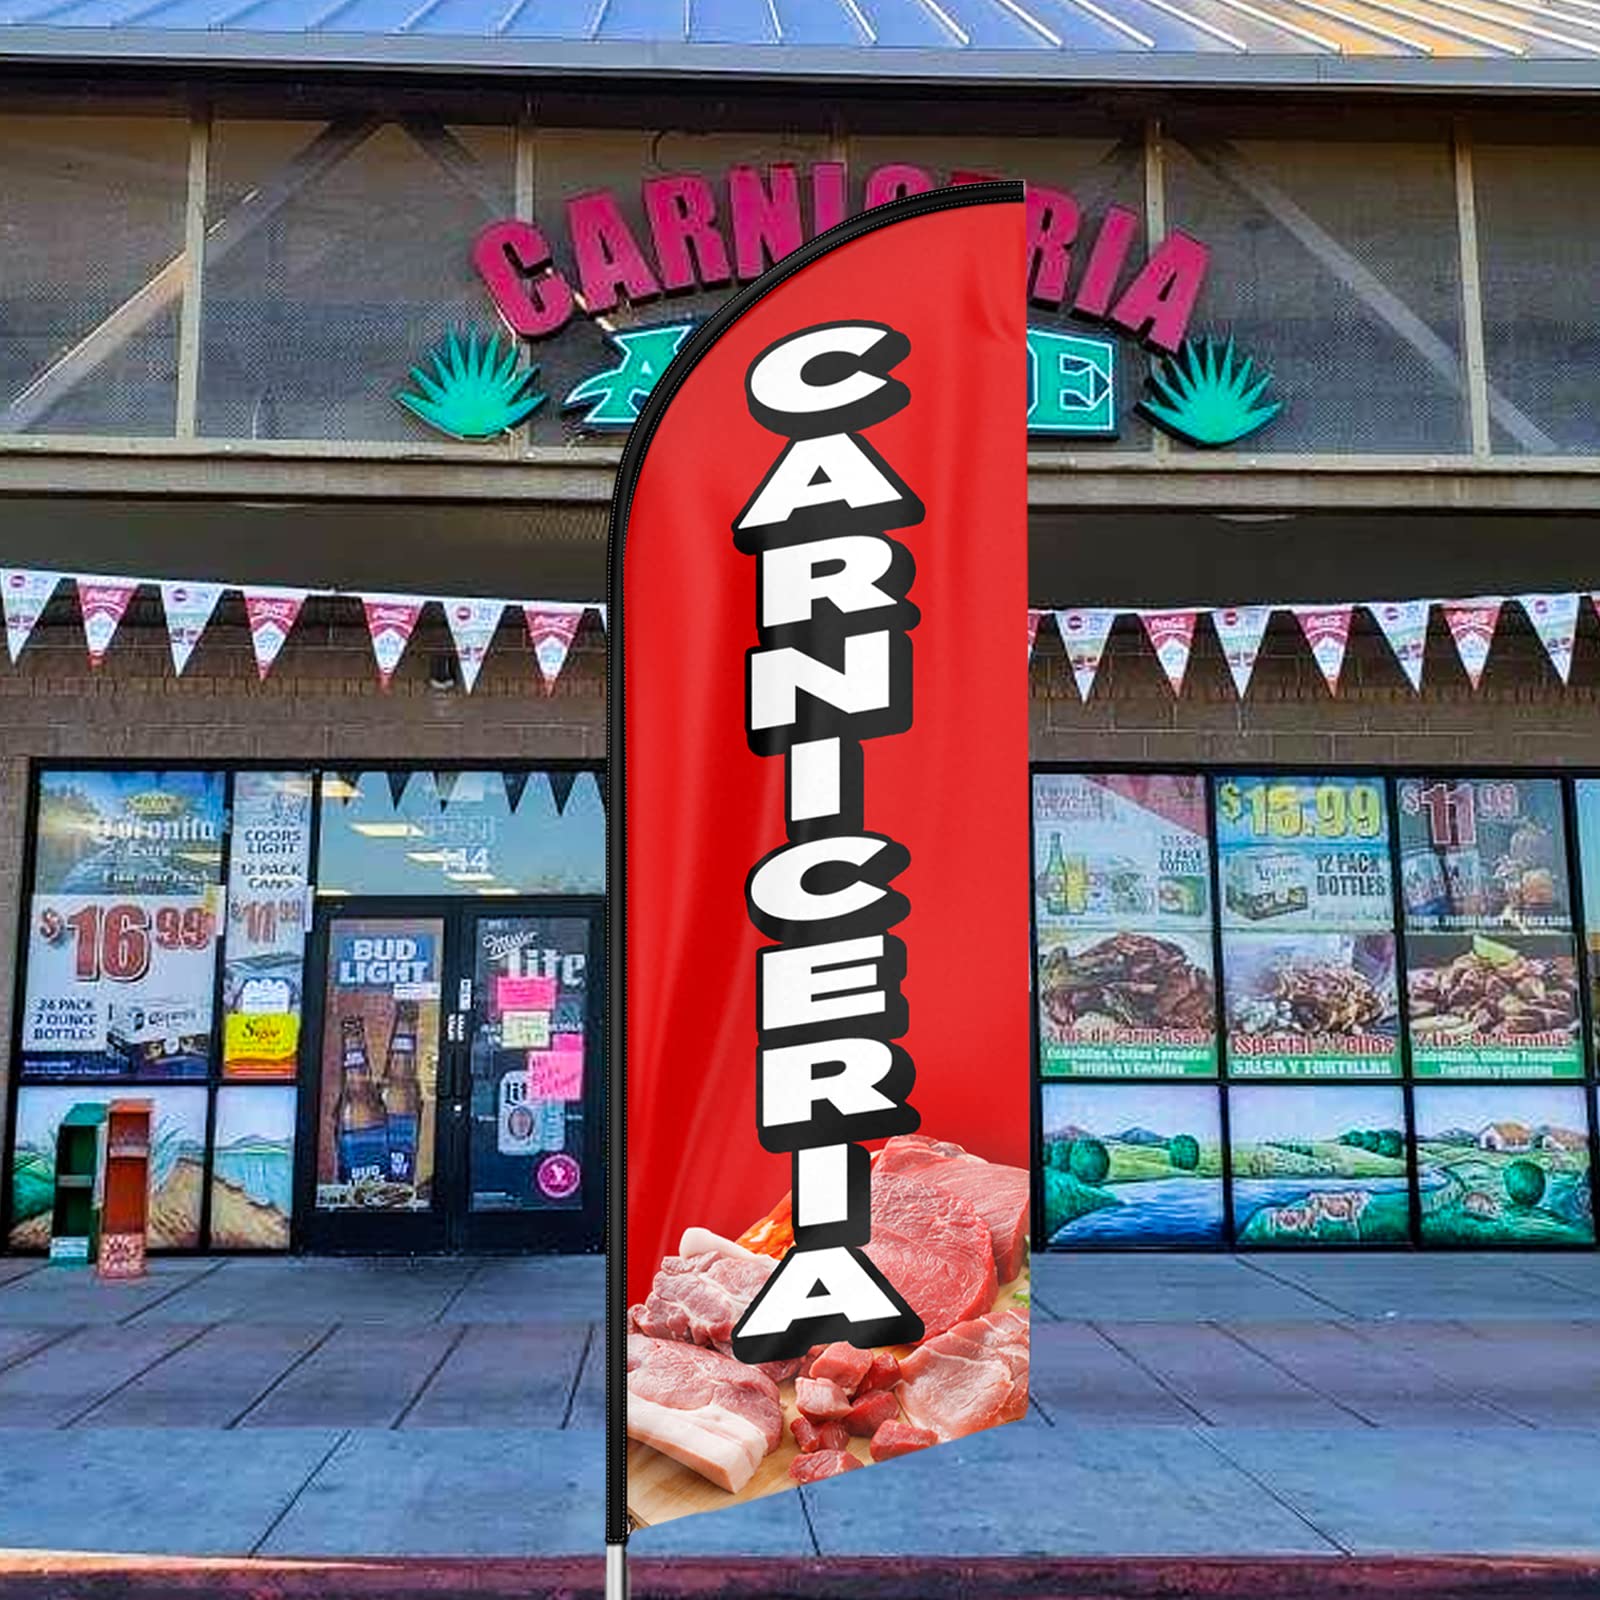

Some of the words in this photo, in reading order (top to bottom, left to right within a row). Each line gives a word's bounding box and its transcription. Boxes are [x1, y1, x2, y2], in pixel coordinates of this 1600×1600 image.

[735, 322, 924, 1362] CARNICERIA
[1317, 875, 1385, 896] BOTTLES
[353, 939, 416, 961] BUD
[339, 962, 429, 984] LIGHT
